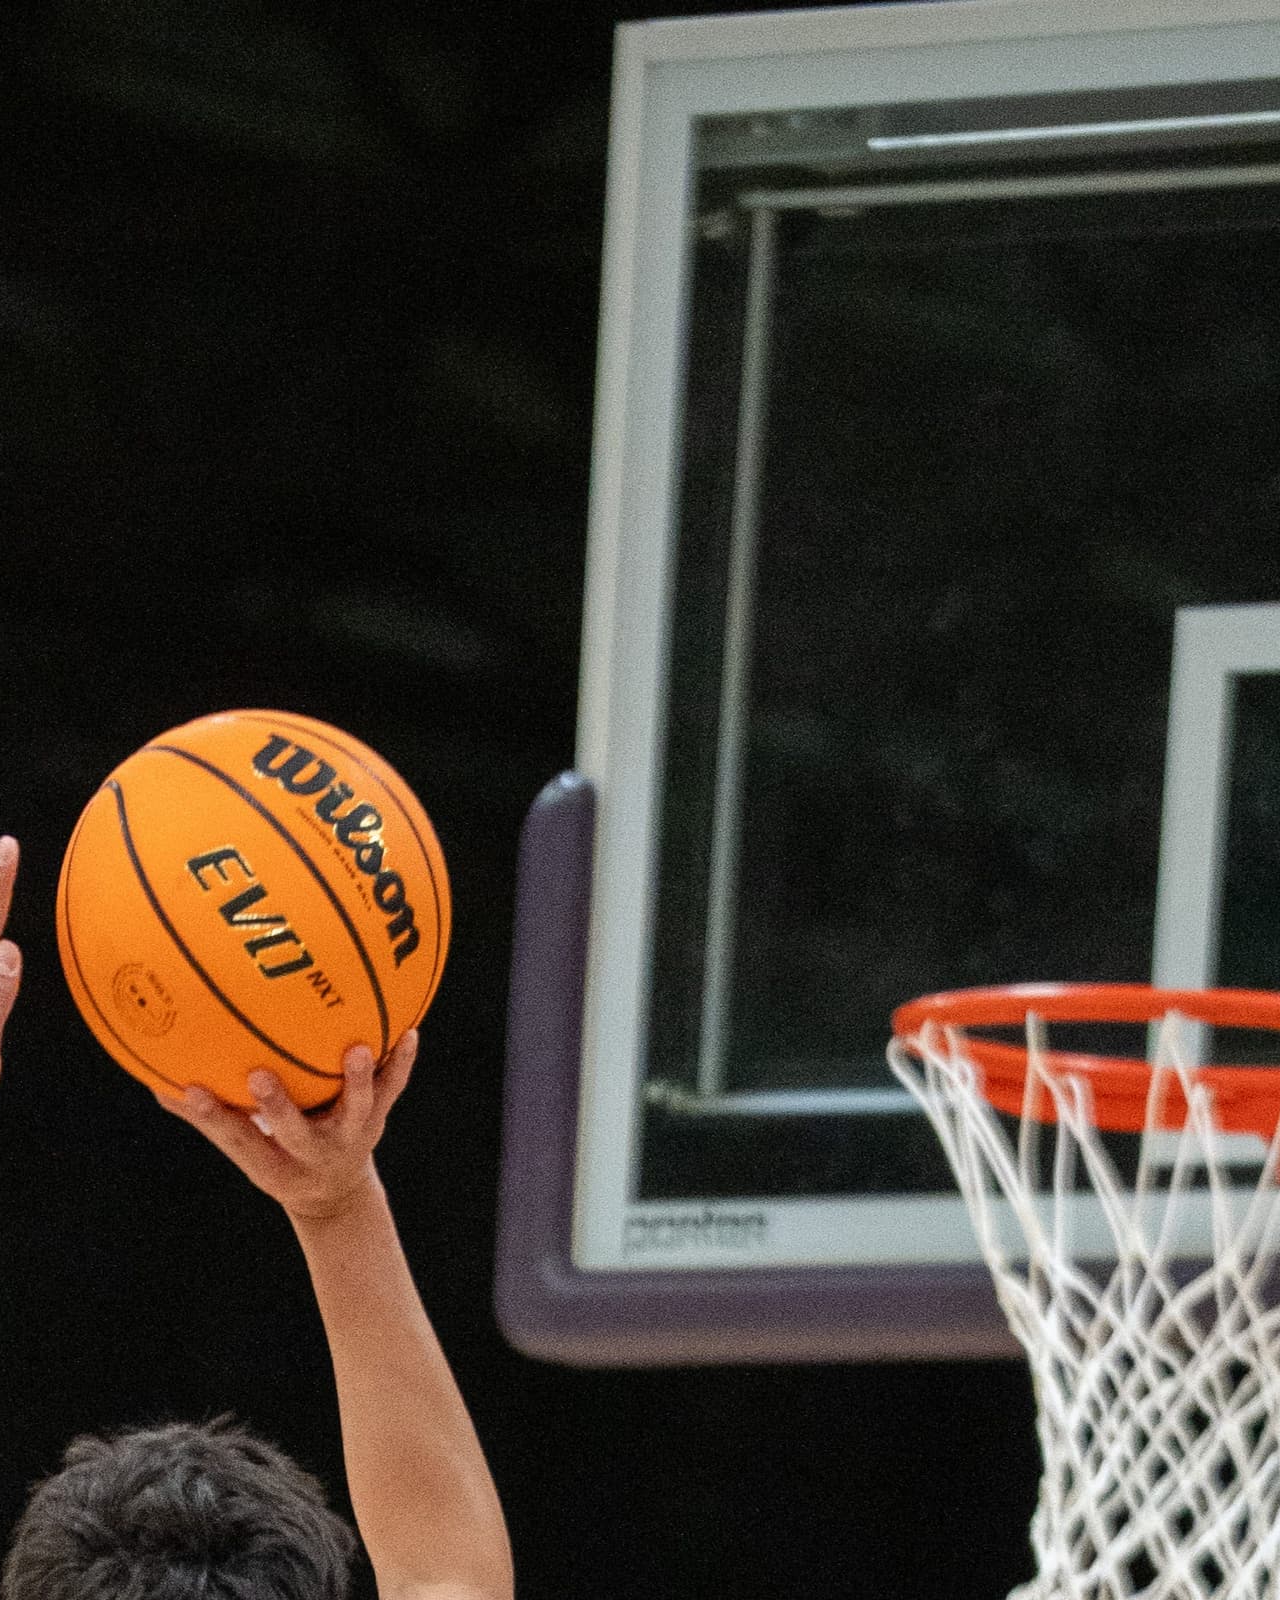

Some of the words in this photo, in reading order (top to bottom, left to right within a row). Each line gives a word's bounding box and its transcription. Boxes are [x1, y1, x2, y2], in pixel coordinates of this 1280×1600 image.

[185, 844, 314, 979] EVO
[306, 969, 344, 1008] NXT
[252, 733, 419, 970] Wilson
